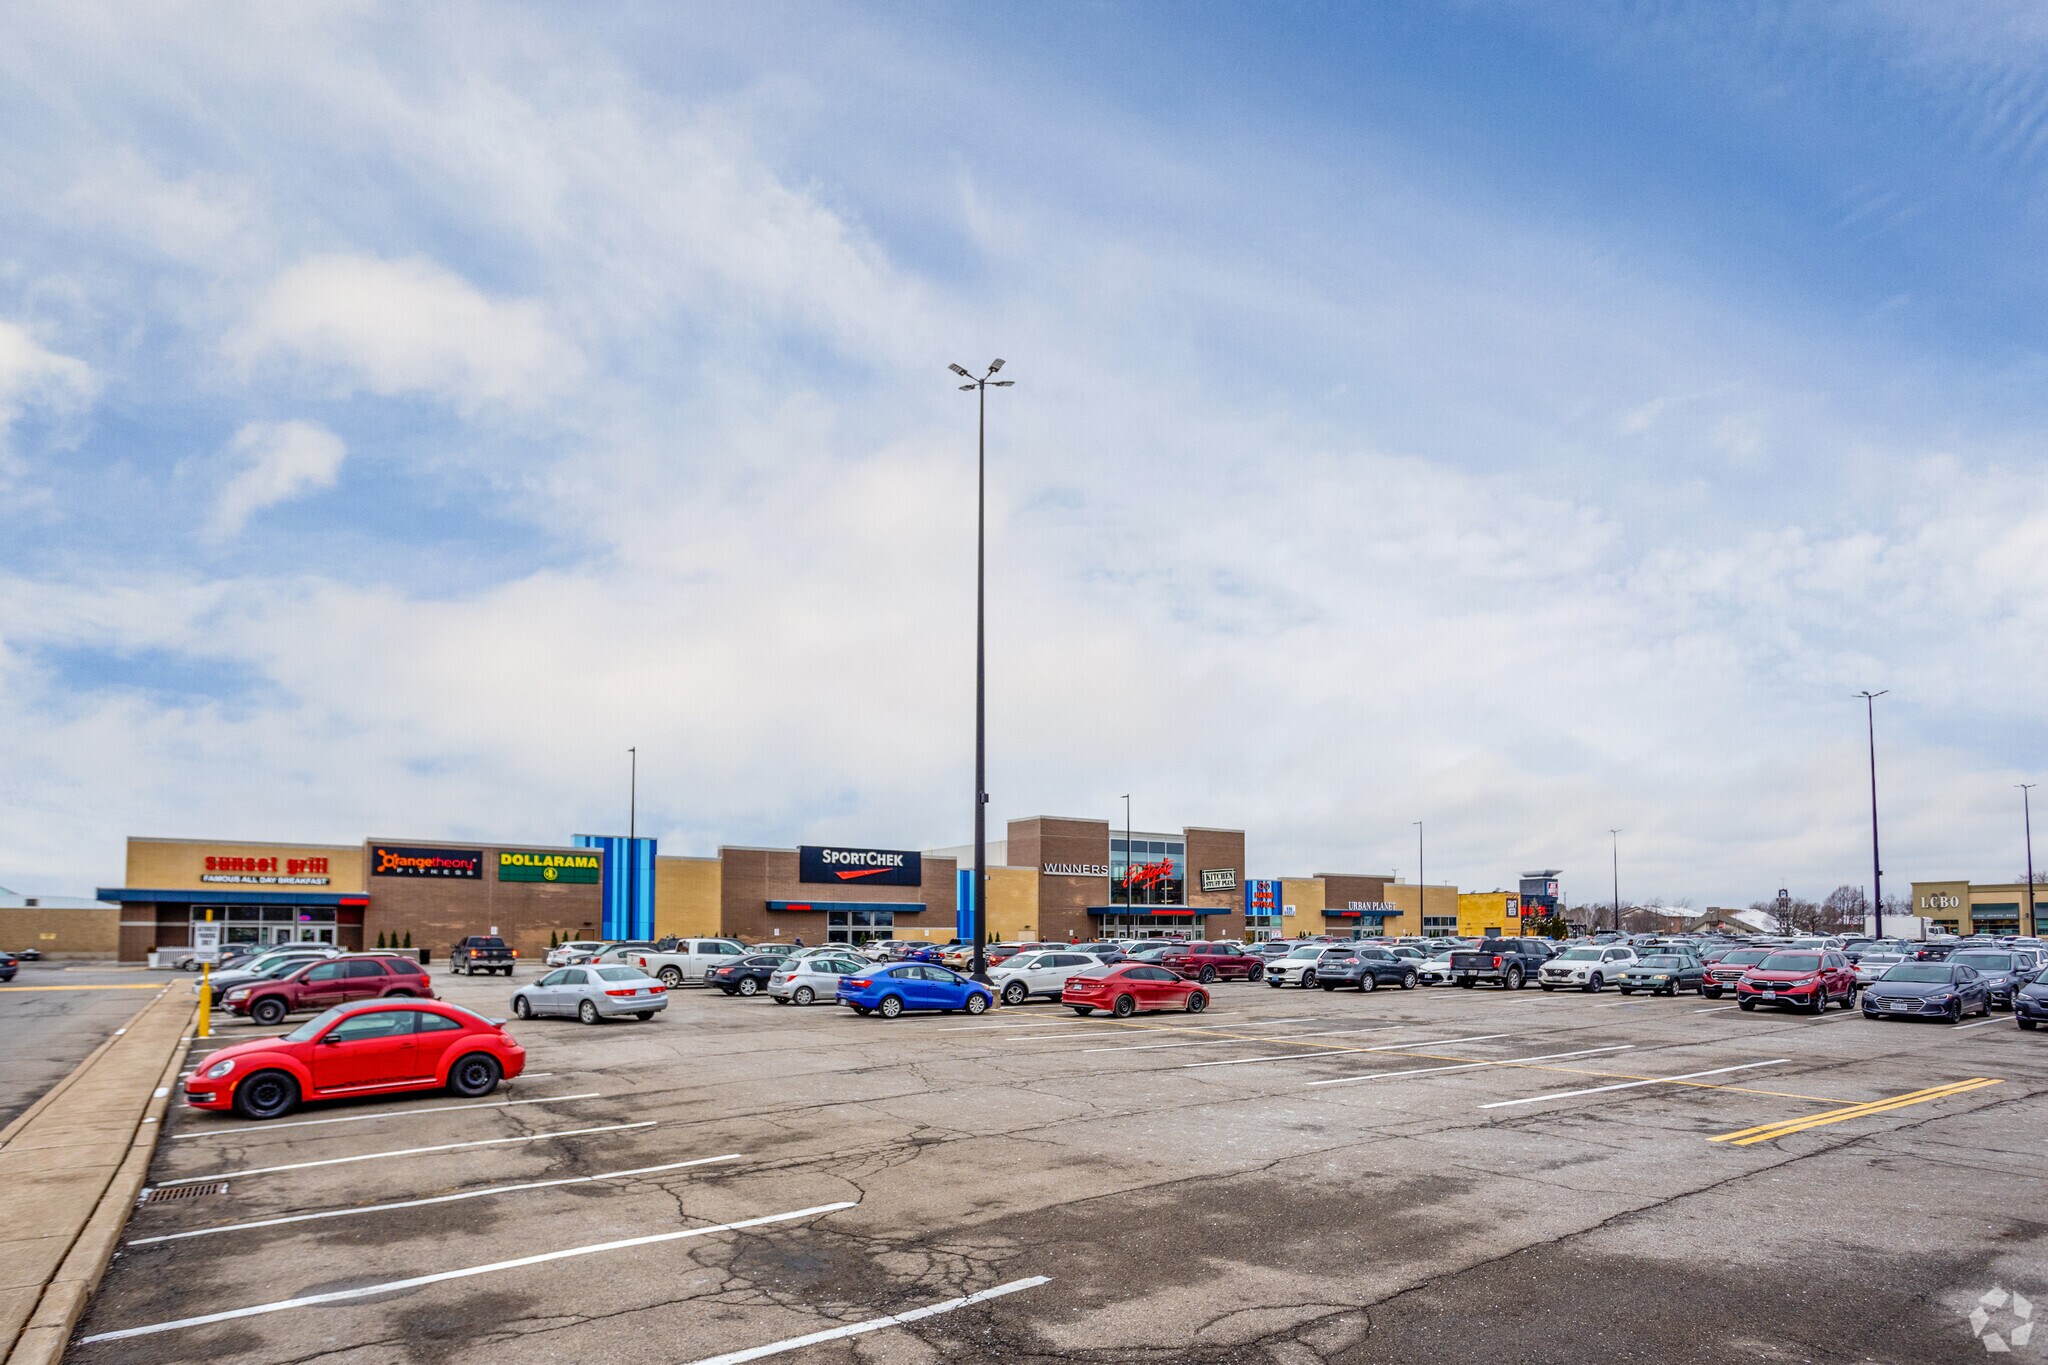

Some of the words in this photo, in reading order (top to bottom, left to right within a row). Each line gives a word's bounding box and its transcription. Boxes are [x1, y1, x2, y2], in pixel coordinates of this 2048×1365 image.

[287, 857, 329, 874] grill
[501, 854, 598, 868] DOLLARAMA
[396, 867, 474, 876] FITNESS
[1044, 863, 1109, 875] WINNERS
[203, 875, 241, 883] FAMOUS
[241, 876, 258, 884] ALL
[277, 877, 327, 885] BREAKFAST
[1205, 872, 1233, 881] KITCHEN
[1348, 901, 1371, 910] URBAN
[1372, 901, 1396, 910] PLANET
[1921, 896, 1959, 908] LCBO
